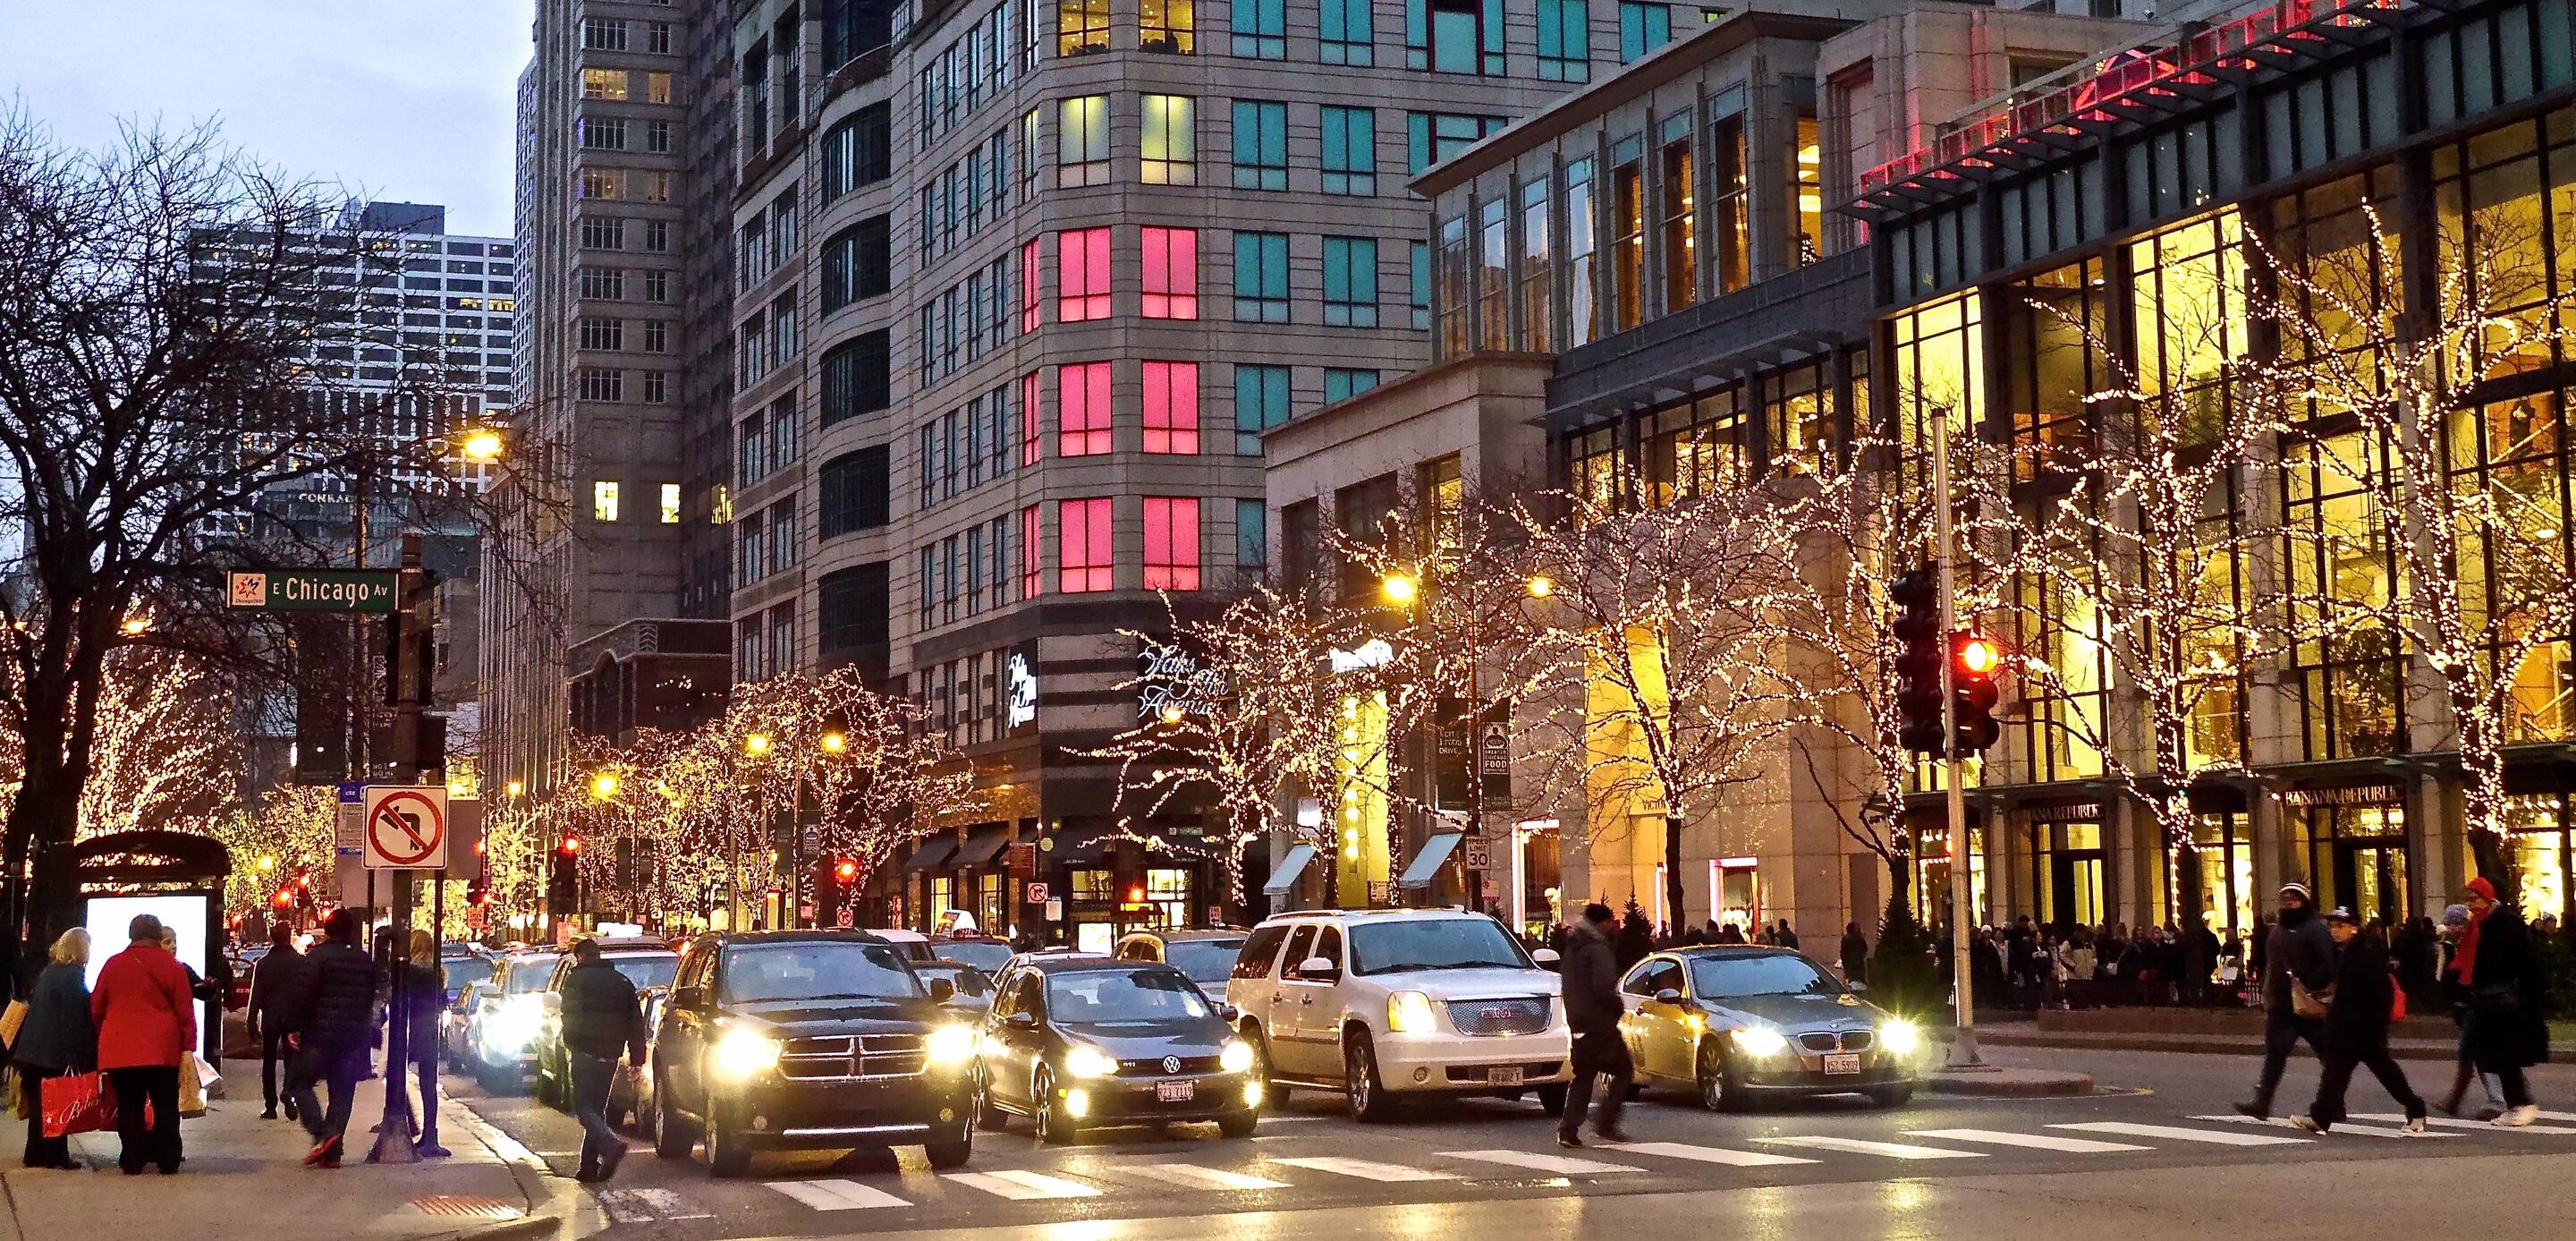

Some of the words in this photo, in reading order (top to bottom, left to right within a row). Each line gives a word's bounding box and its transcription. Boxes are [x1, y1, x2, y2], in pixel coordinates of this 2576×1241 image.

[273, 582, 280, 595] E
[286, 577, 369, 608] Chicago
[374, 584, 387, 596] Av
[2285, 789, 2339, 806] BANANA
[2340, 785, 2405, 803] REPUBLIC
[2054, 803, 2104, 820] REPUBLIC
[1469, 853, 1488, 865] 30
[1174, 1086, 1192, 1097] 7119
